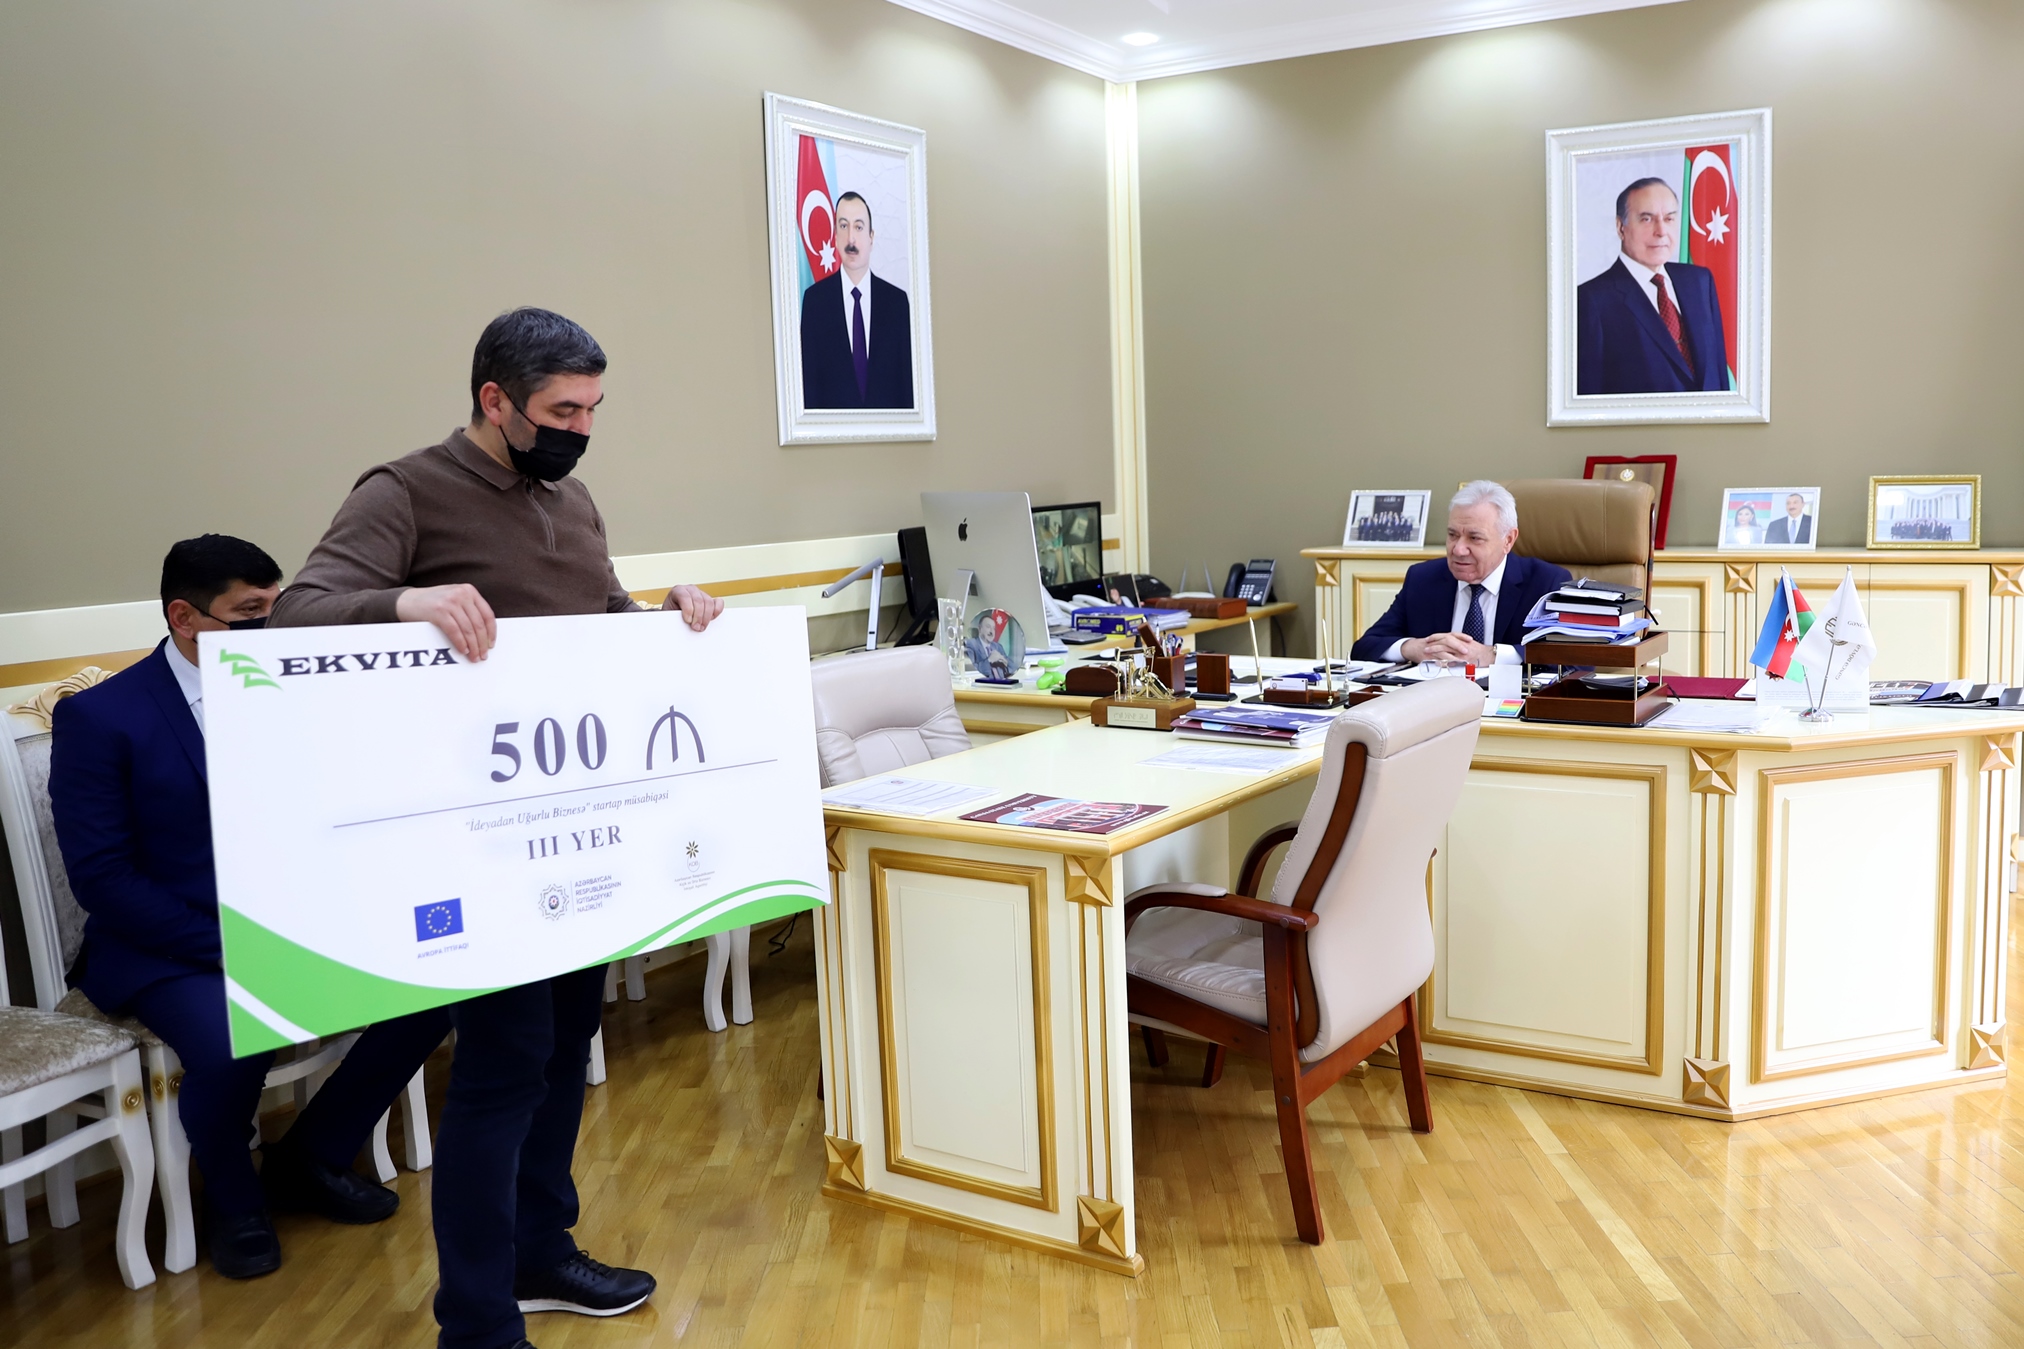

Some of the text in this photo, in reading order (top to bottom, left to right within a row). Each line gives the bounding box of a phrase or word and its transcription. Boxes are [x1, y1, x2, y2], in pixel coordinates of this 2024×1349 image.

[1847, 620, 1867, 629] GƏNC
[277, 646, 459, 677] EKVITA
[1846, 644, 1862, 663] DÖVLƏ
[490, 712, 607, 783] 500
[517, 811, 550, 824] Uğurlu
[592, 800, 622, 812] startap
[527, 824, 623, 860] III YER
[417, 948, 443, 959] AVROPA
